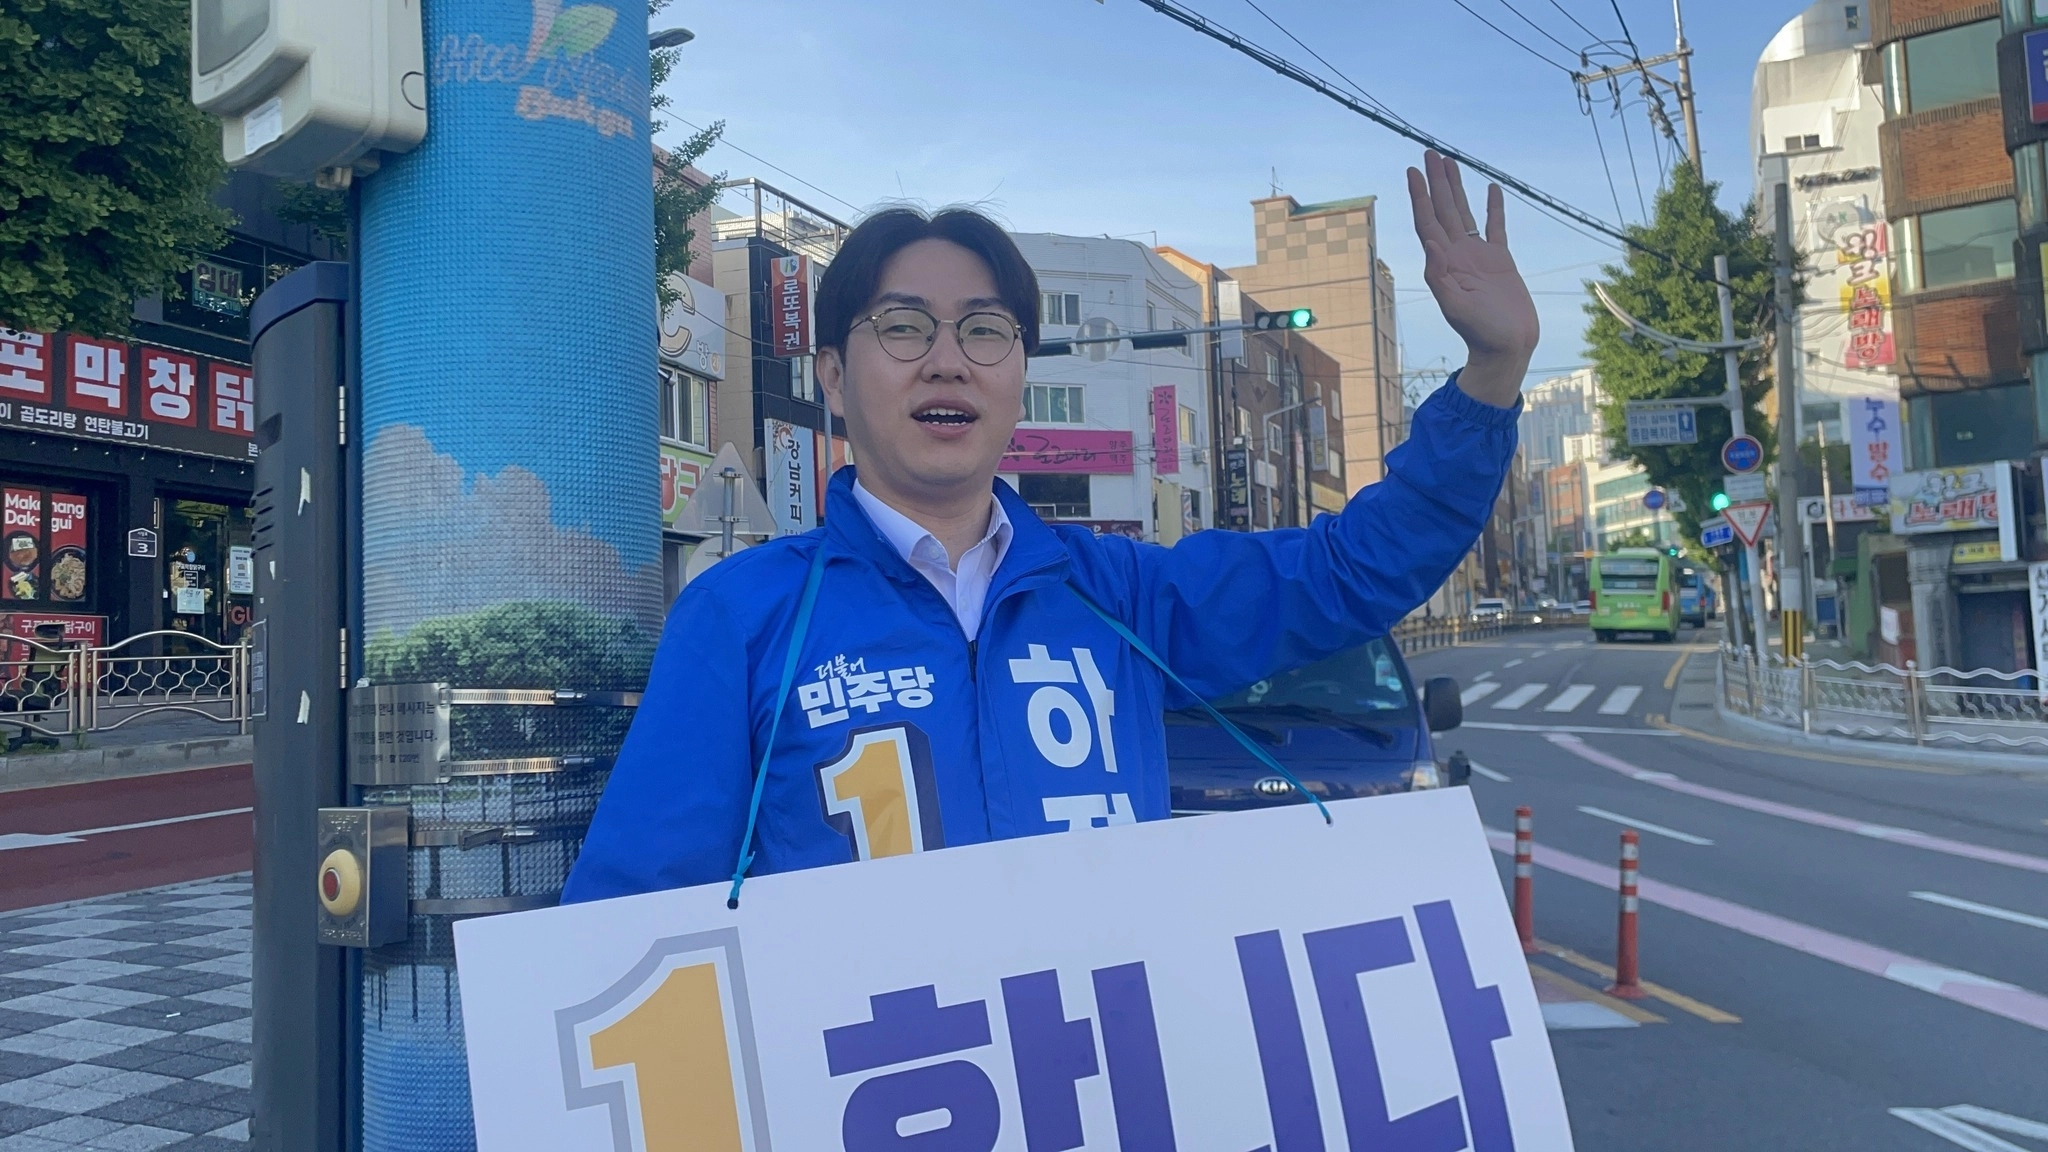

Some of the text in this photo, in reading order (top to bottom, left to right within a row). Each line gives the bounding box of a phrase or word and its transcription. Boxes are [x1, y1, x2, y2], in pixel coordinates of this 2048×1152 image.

[782, 279, 801, 351] 로또복권
[20, 405, 77, 429] 곱도리탕
[84, 416, 149, 440] 연탄불고기
[788, 439, 802, 525] 강남커피
[137, 543, 148, 553] 3
[21, 619, 95, 634] 구닭구이
[814, 654, 866, 680] 더불어
[798, 666, 935, 729] 민주당
[820, 727, 924, 860] 1
[1260, 780, 1290, 794] KIA
[575, 945, 765, 1152] 1
